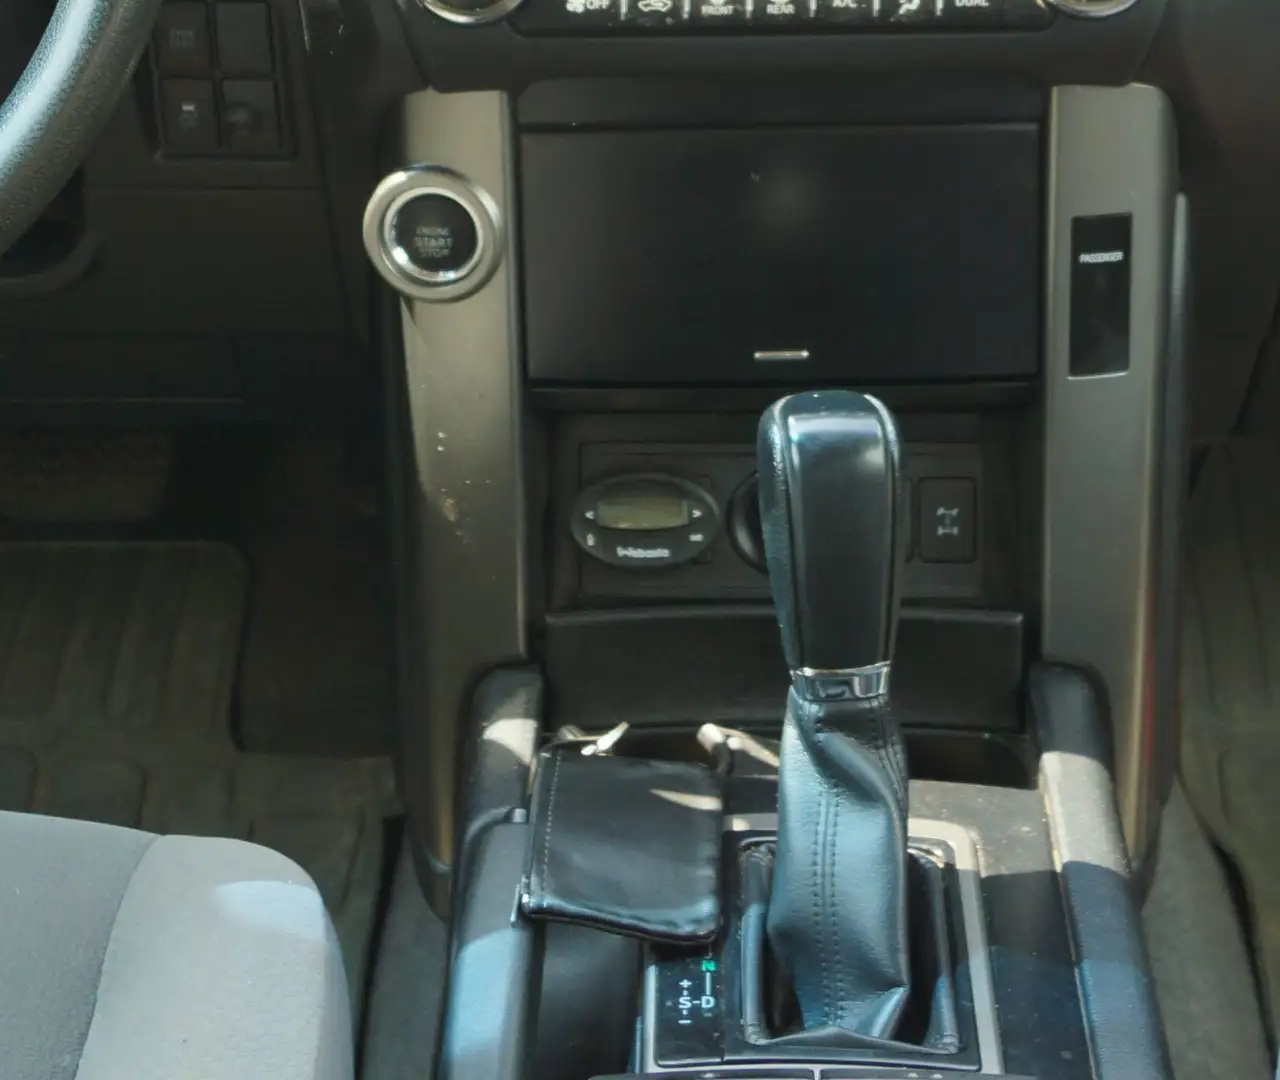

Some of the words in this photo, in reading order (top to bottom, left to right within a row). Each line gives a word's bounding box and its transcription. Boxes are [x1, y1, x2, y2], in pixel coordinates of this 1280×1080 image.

[701, 5, 735, 16] FRONT
[766, 5, 795, 15] REAR
[701, 960, 717, 971] N
